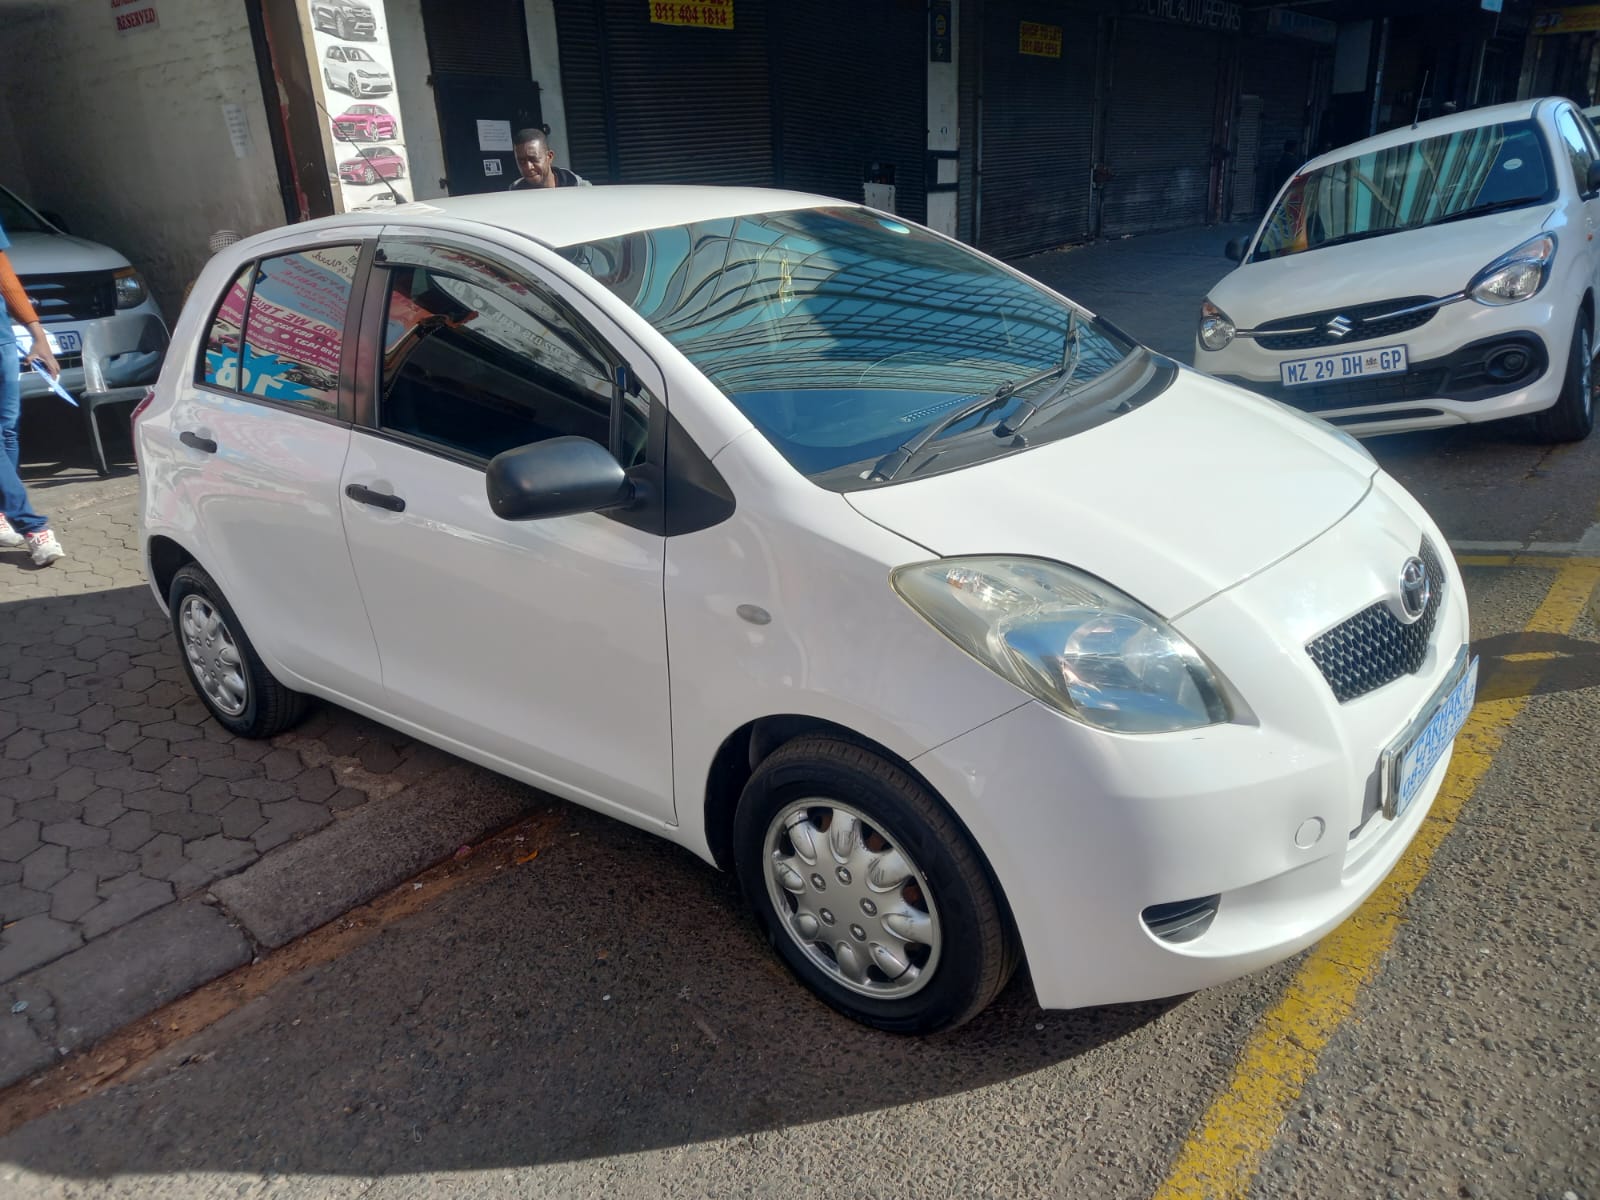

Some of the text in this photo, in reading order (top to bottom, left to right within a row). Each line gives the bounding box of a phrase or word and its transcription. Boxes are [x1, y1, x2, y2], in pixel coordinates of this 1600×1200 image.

[116, 8, 155, 31] RESERVED
[655, 3, 675, 22] 011
[59, 334, 76, 350] GP
[1287, 349, 1402, 383] MZ 29 DH GP
